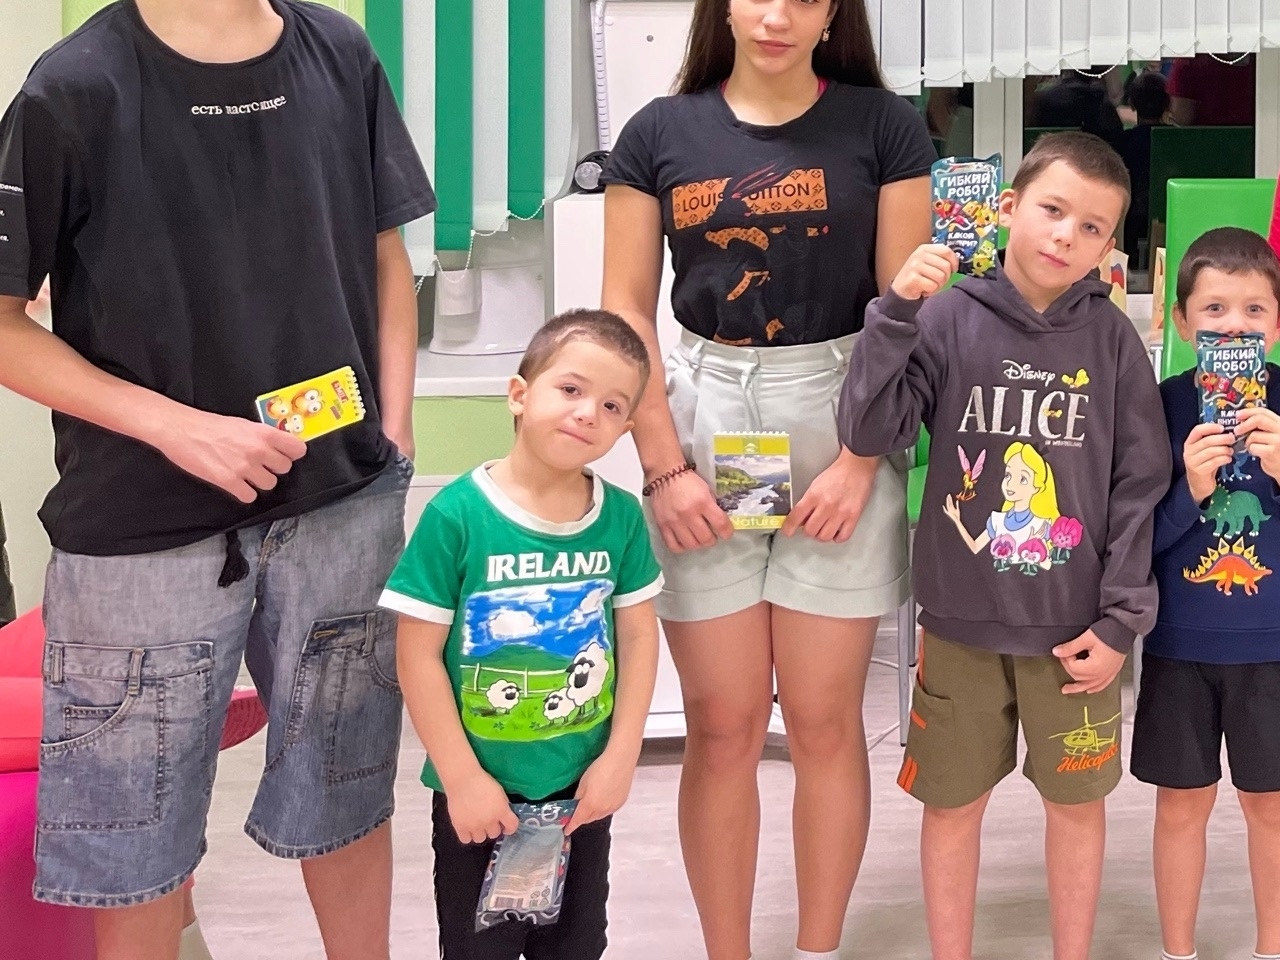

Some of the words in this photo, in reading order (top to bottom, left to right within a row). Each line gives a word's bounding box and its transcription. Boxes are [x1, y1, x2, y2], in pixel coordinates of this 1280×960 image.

[191, 105, 223, 115] есть
[940, 172, 991, 188] ГИБКИЙ
[947, 185, 990, 199] РОБОТ
[682, 191, 724, 213] LOUIS
[1205, 347, 1256, 361] ГИБКИЙ
[1213, 360, 1254, 372] РОБОТ
[957, 385, 1090, 441] ALICE
[1217, 418, 1239, 426] ВНУТ
[486, 550, 612, 583] IRELAND
